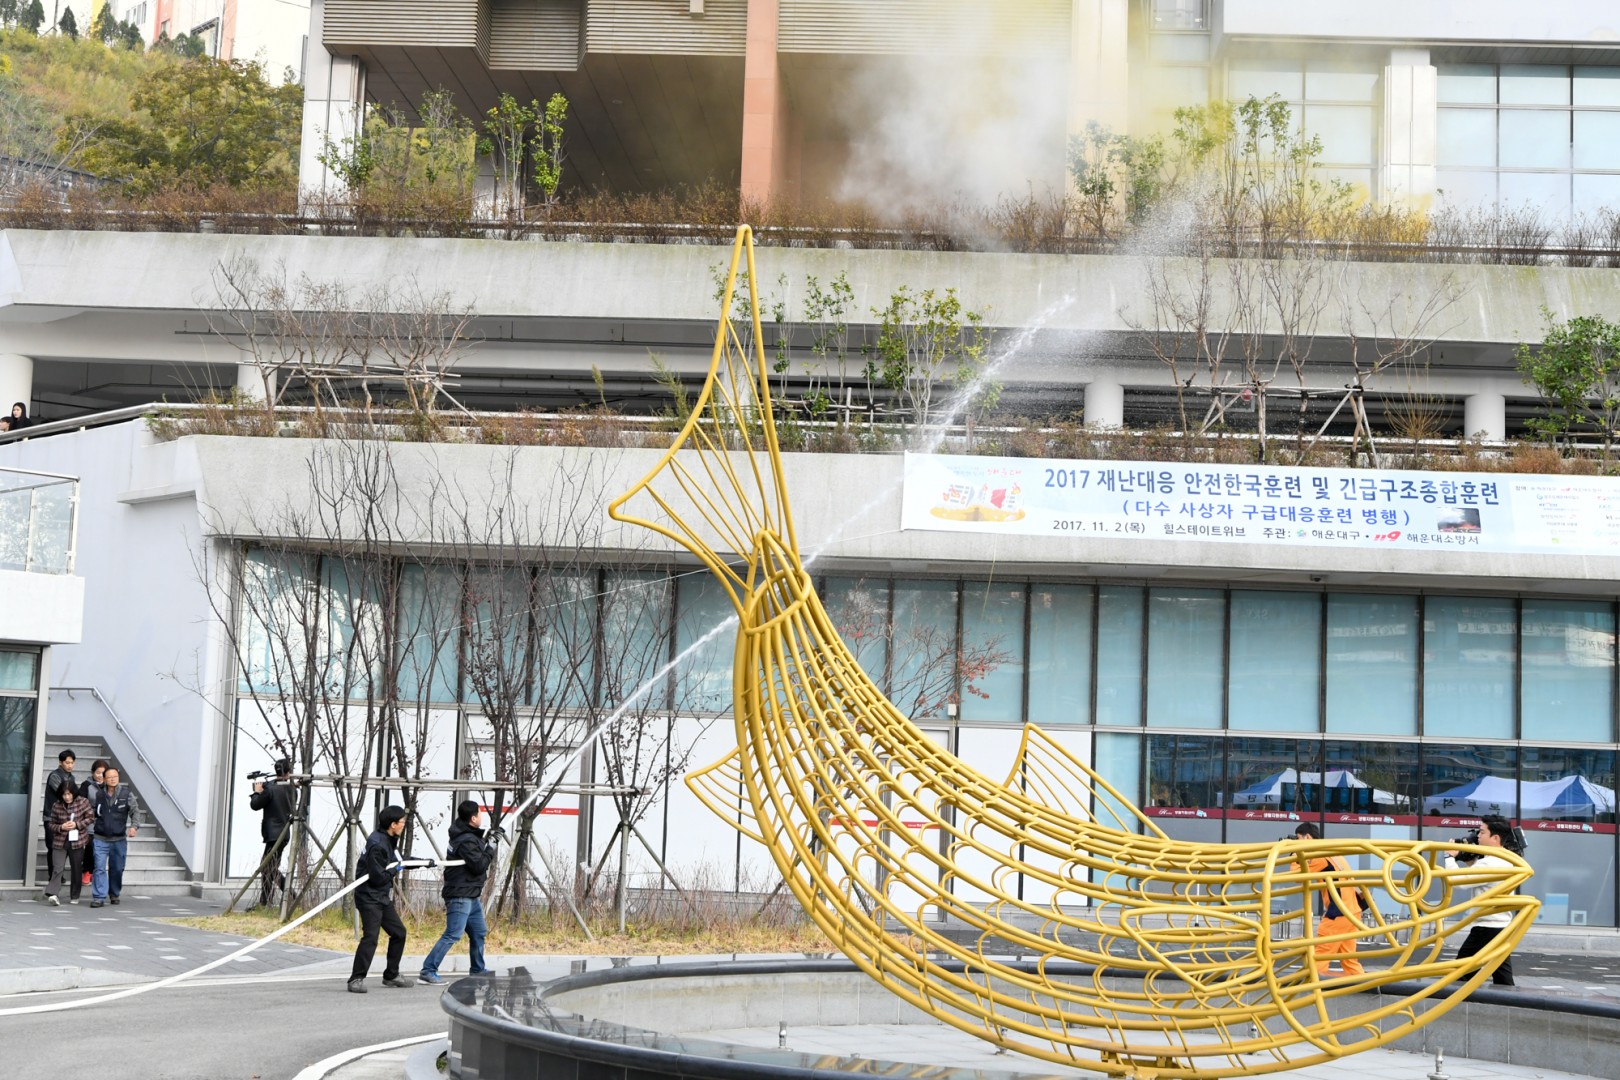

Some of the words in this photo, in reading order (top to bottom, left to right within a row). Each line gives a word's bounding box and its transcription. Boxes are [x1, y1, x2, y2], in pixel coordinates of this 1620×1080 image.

[1044, 468, 1089, 489] 2017
[1096, 469, 1176, 494] 재난대응
[1184, 472, 1303, 499] 안전한국훈련
[1312, 475, 1331, 500] 및
[1340, 477, 1500, 506] 긴급구조종합훈련
[1122, 500, 1171, 517] (다수
[1180, 502, 1234, 520] 사상자
[1242, 504, 1353, 525] 구급대응훈련
[1362, 508, 1410, 527] 병행)
[1053, 520, 1086, 532] 2017.
[1092, 521, 1109, 533] 11.
[1163, 523, 1246, 538] 힐스테이트위브
[1262, 527, 1292, 540] 주관:
[1311, 529, 1361, 542] 해운대구
[1406, 532, 1480, 546] 해운대소방서
